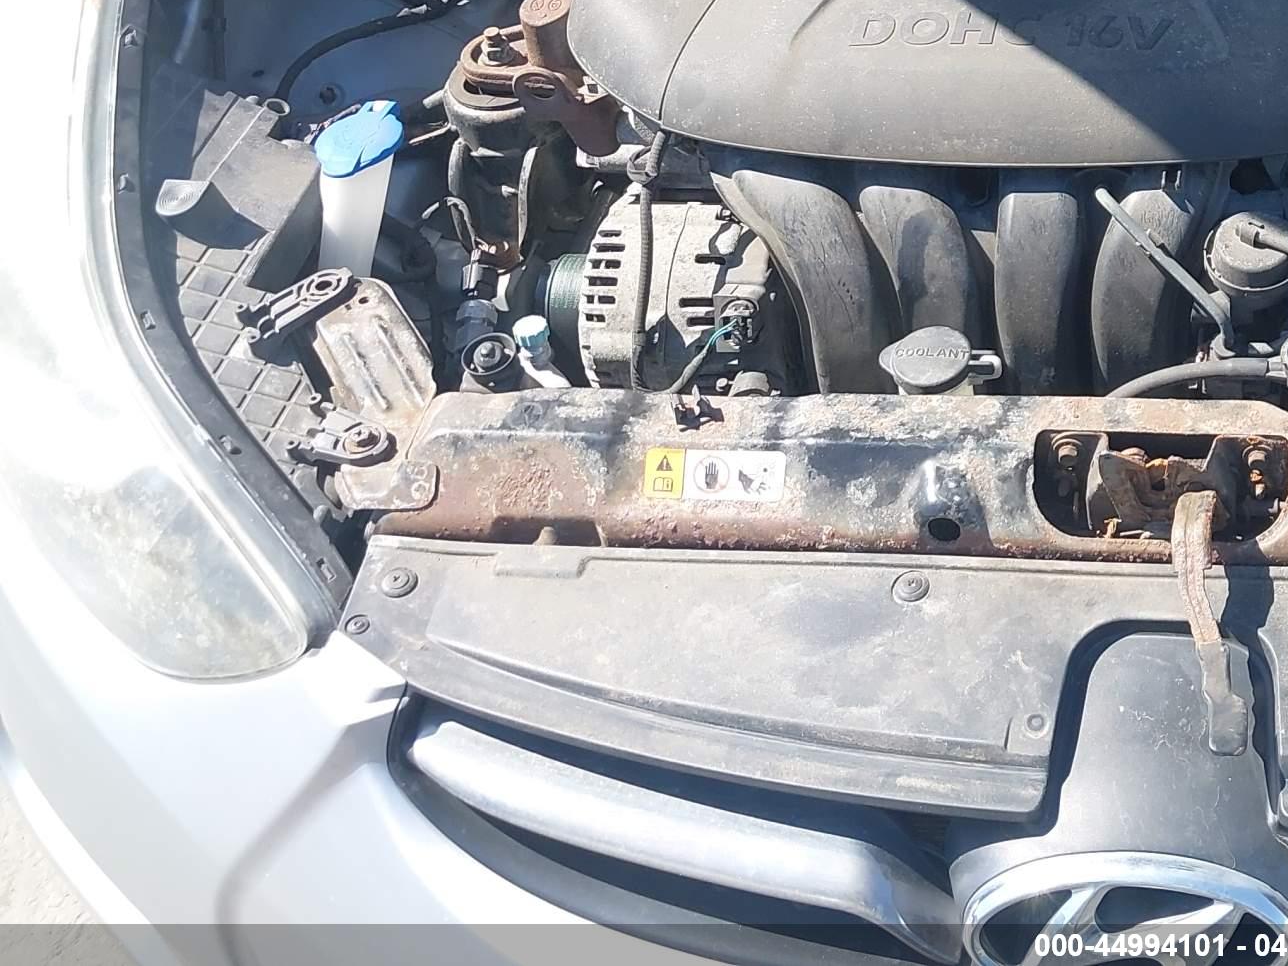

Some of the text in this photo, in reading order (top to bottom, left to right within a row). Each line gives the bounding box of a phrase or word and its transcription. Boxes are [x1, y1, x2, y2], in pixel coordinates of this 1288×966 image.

[847, 11, 1175, 50] DOHC 16V
[895, 346, 970, 360] COOLANT
